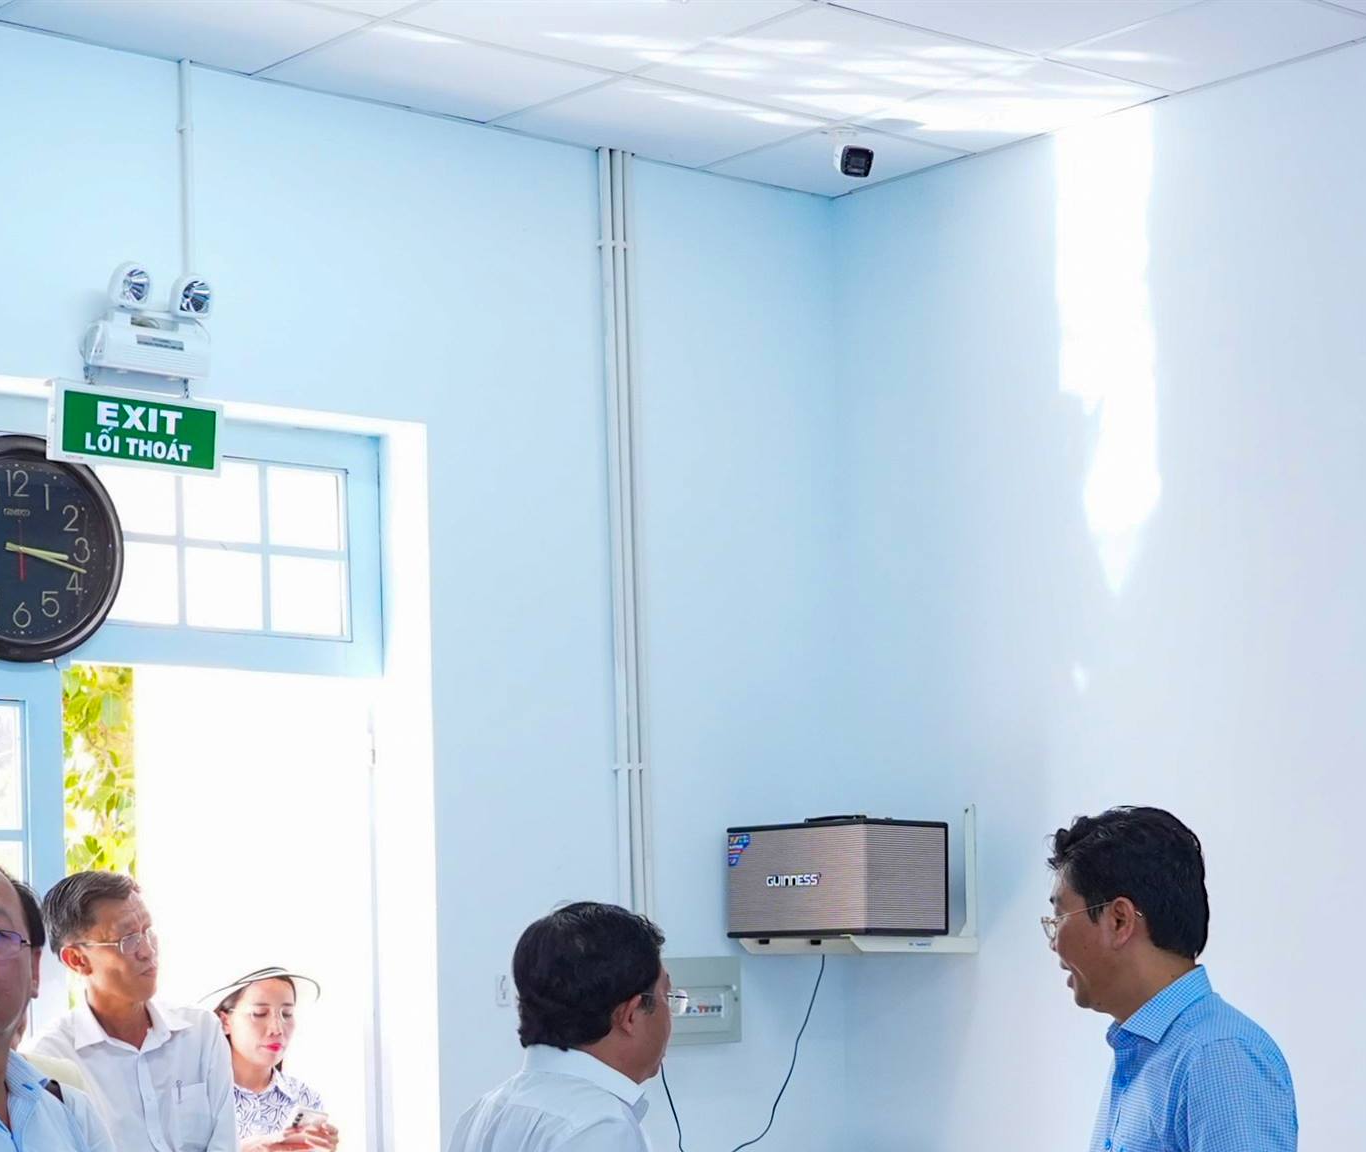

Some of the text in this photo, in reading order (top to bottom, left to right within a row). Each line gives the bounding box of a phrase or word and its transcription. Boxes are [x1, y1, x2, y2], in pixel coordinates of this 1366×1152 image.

[96, 400, 183, 435] EXIT
[85, 426, 192, 462] LỐI THOÁT
[5, 469, 30, 497] 12
[44, 483, 51, 511] 1
[62, 504, 80, 532] 2
[73, 537, 91, 563] 3
[65, 571, 83, 596] 4
[12, 601, 33, 629] 6
[41, 590, 61, 618] 5
[766, 873, 819, 888] GUINNESS
